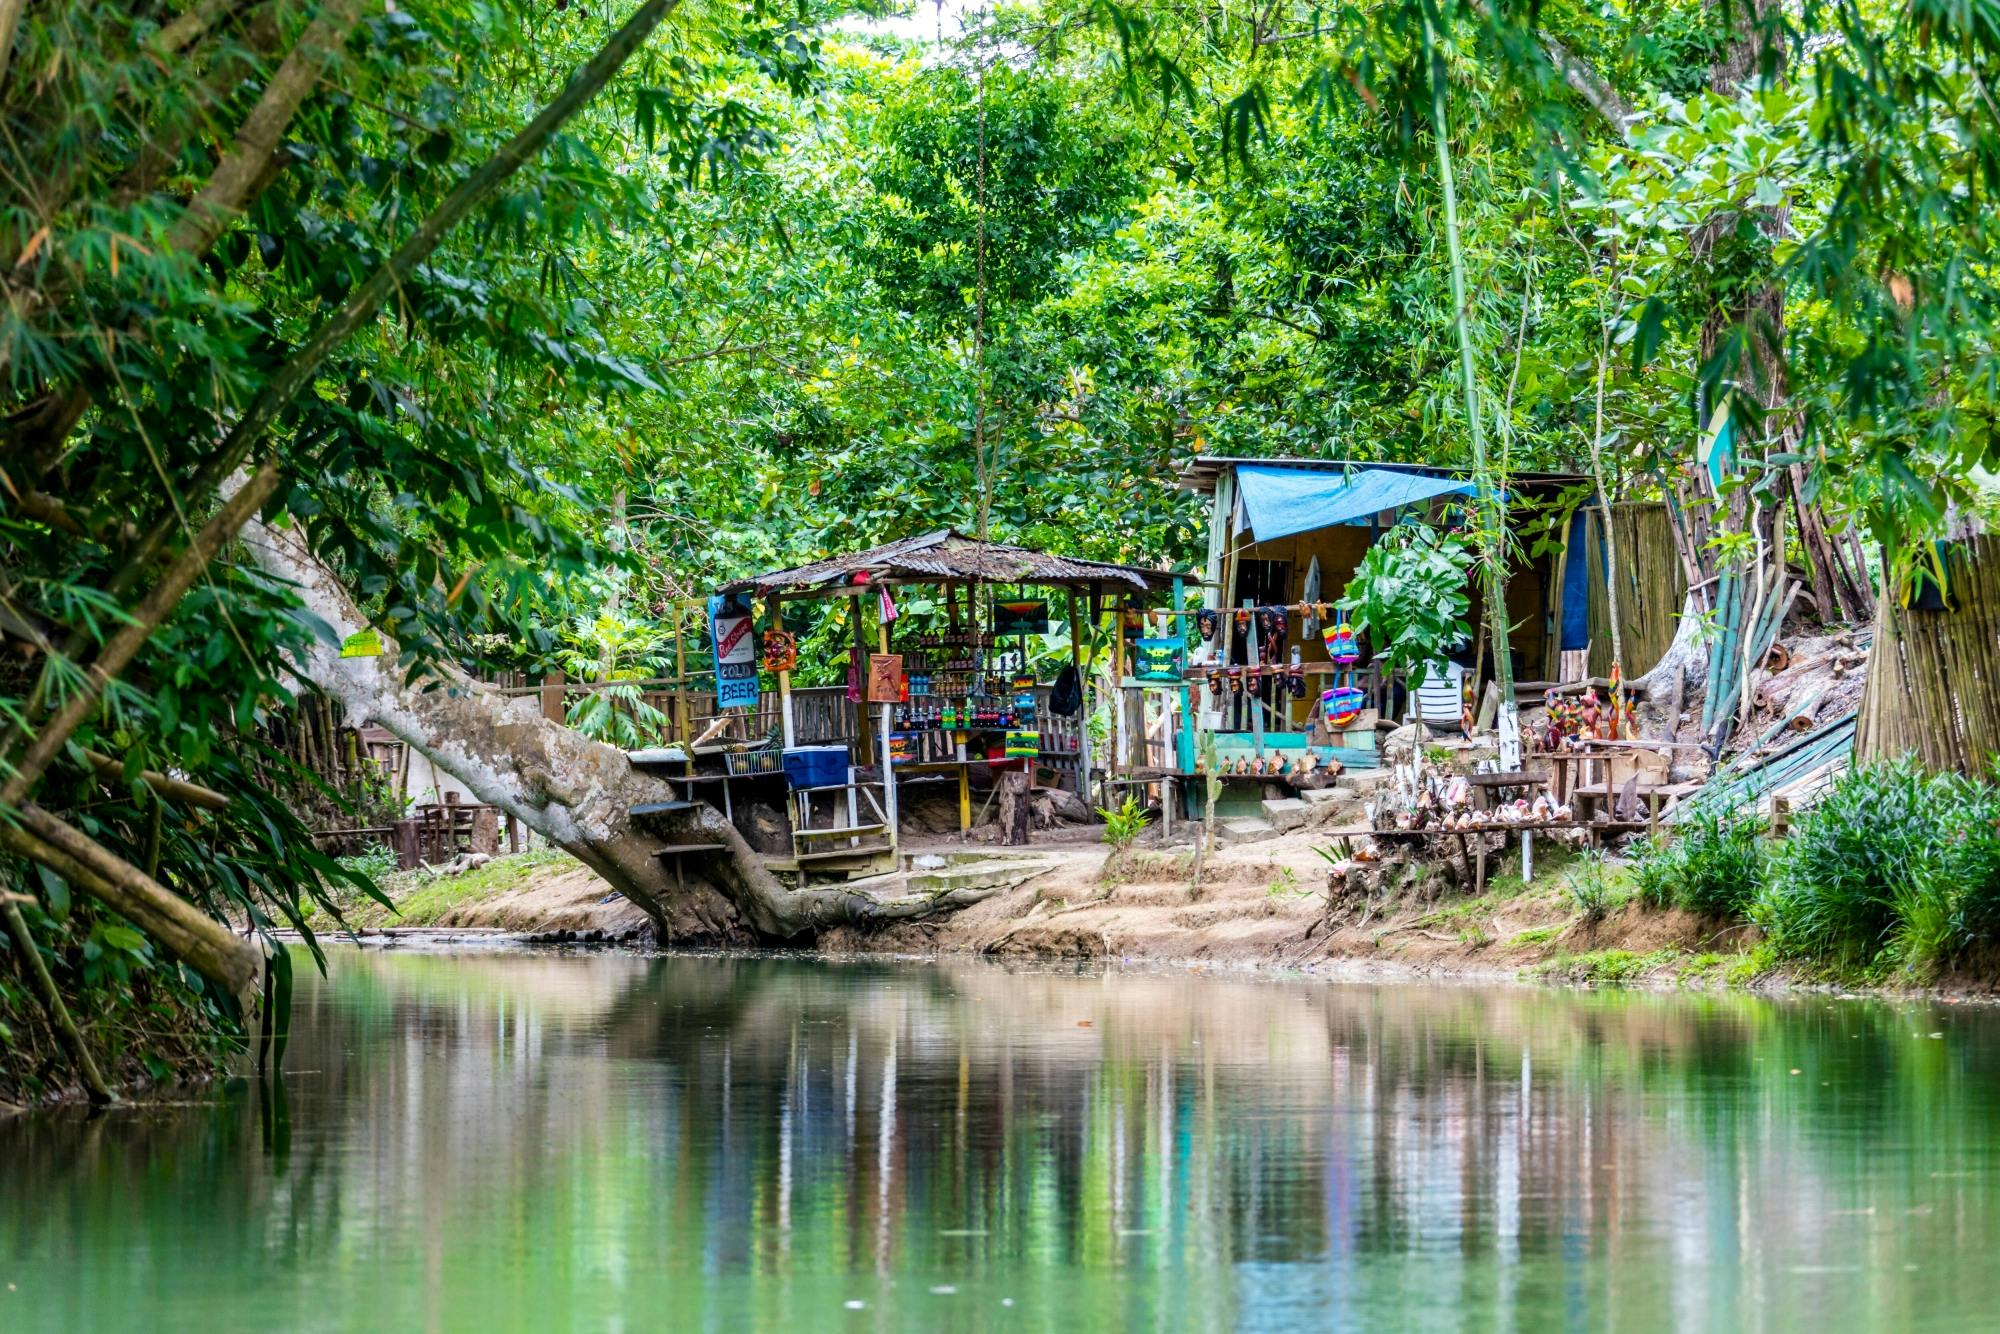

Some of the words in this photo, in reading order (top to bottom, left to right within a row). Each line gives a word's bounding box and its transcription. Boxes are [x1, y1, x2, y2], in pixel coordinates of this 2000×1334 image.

[718, 639, 732, 658] Red
[721, 664, 751, 678] COLD
[721, 682, 757, 702] BEER
